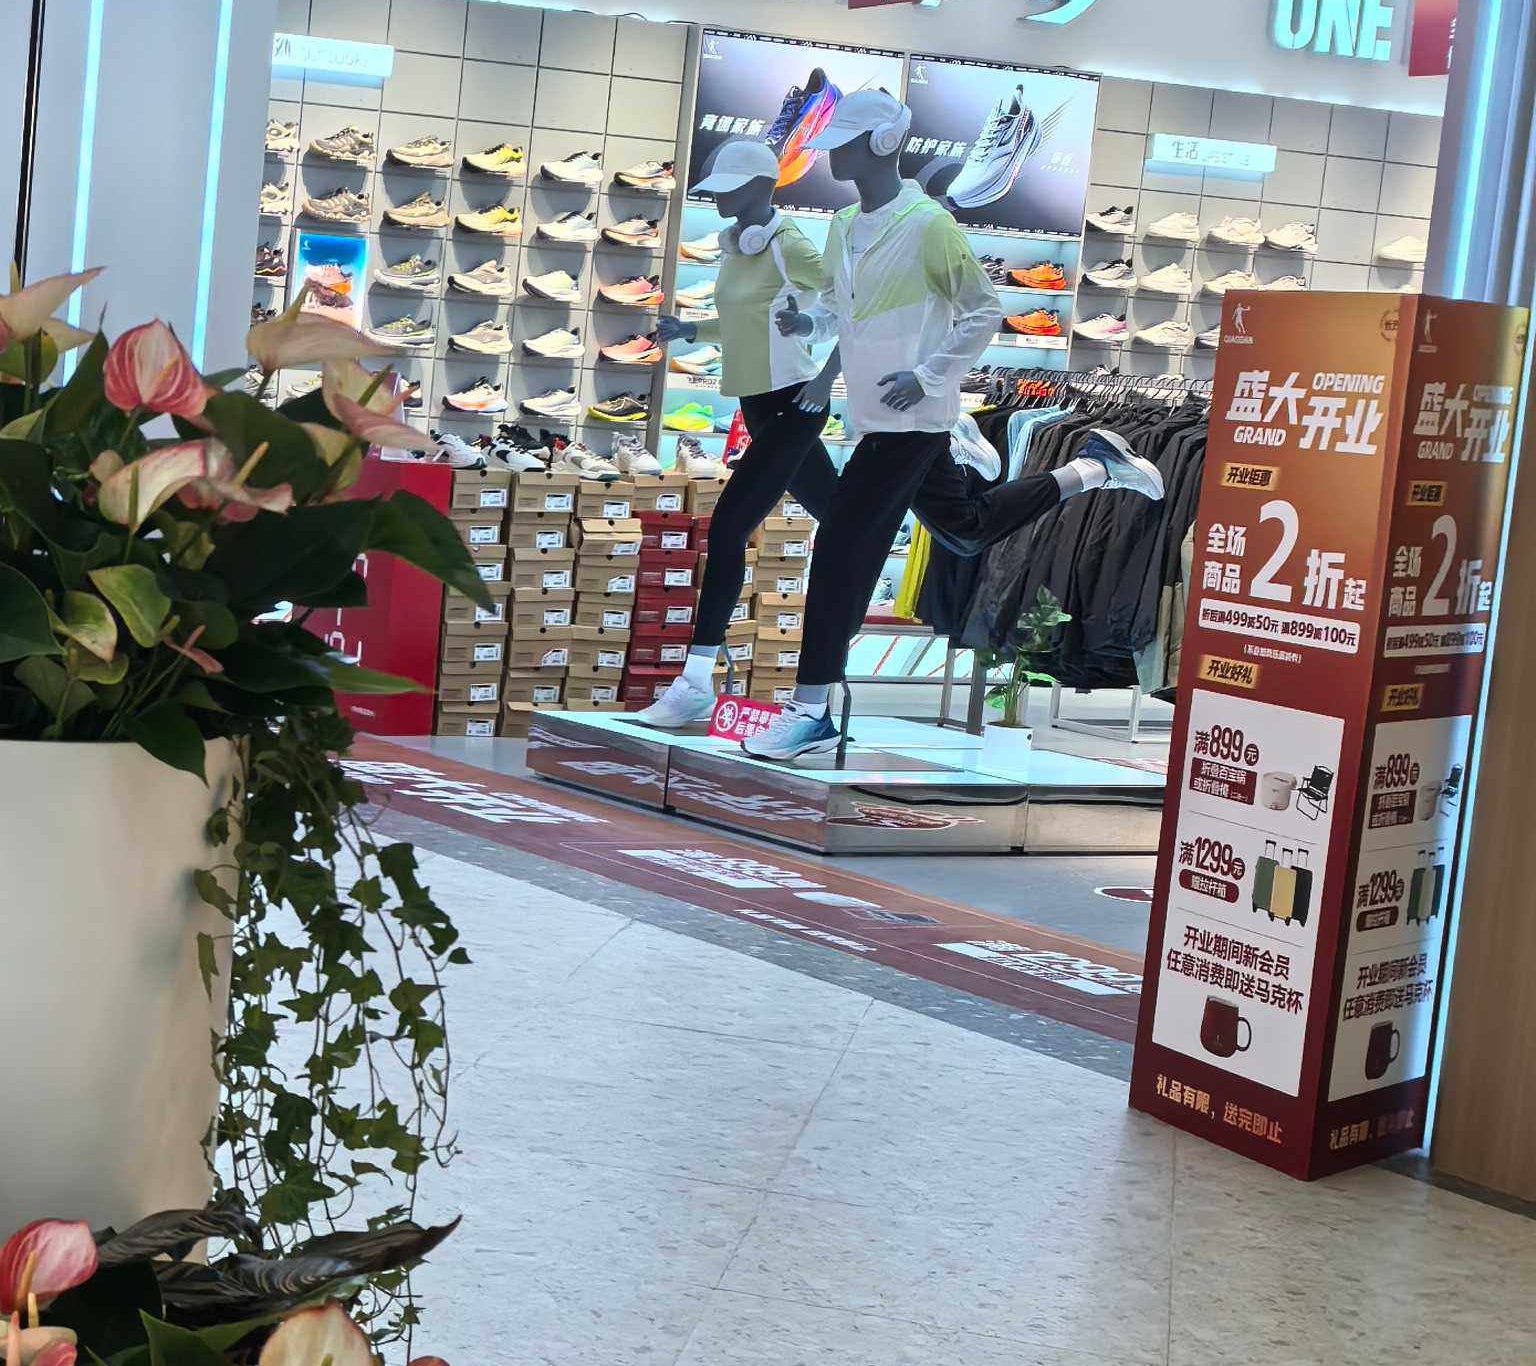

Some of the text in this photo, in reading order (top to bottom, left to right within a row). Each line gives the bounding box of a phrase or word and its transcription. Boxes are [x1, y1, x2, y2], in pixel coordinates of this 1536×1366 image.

[1311, 372, 1385, 394] OPENING
[1233, 425, 1287, 447] GRAND
[1417, 440, 1454, 460] GRAND
[1206, 523, 1248, 557] 全场
[1202, 560, 1241, 594] 商品
[1184, 925, 1291, 981] 开业期间新会员
[1166, 947, 1305, 1015] 任意消费即送马克杯
